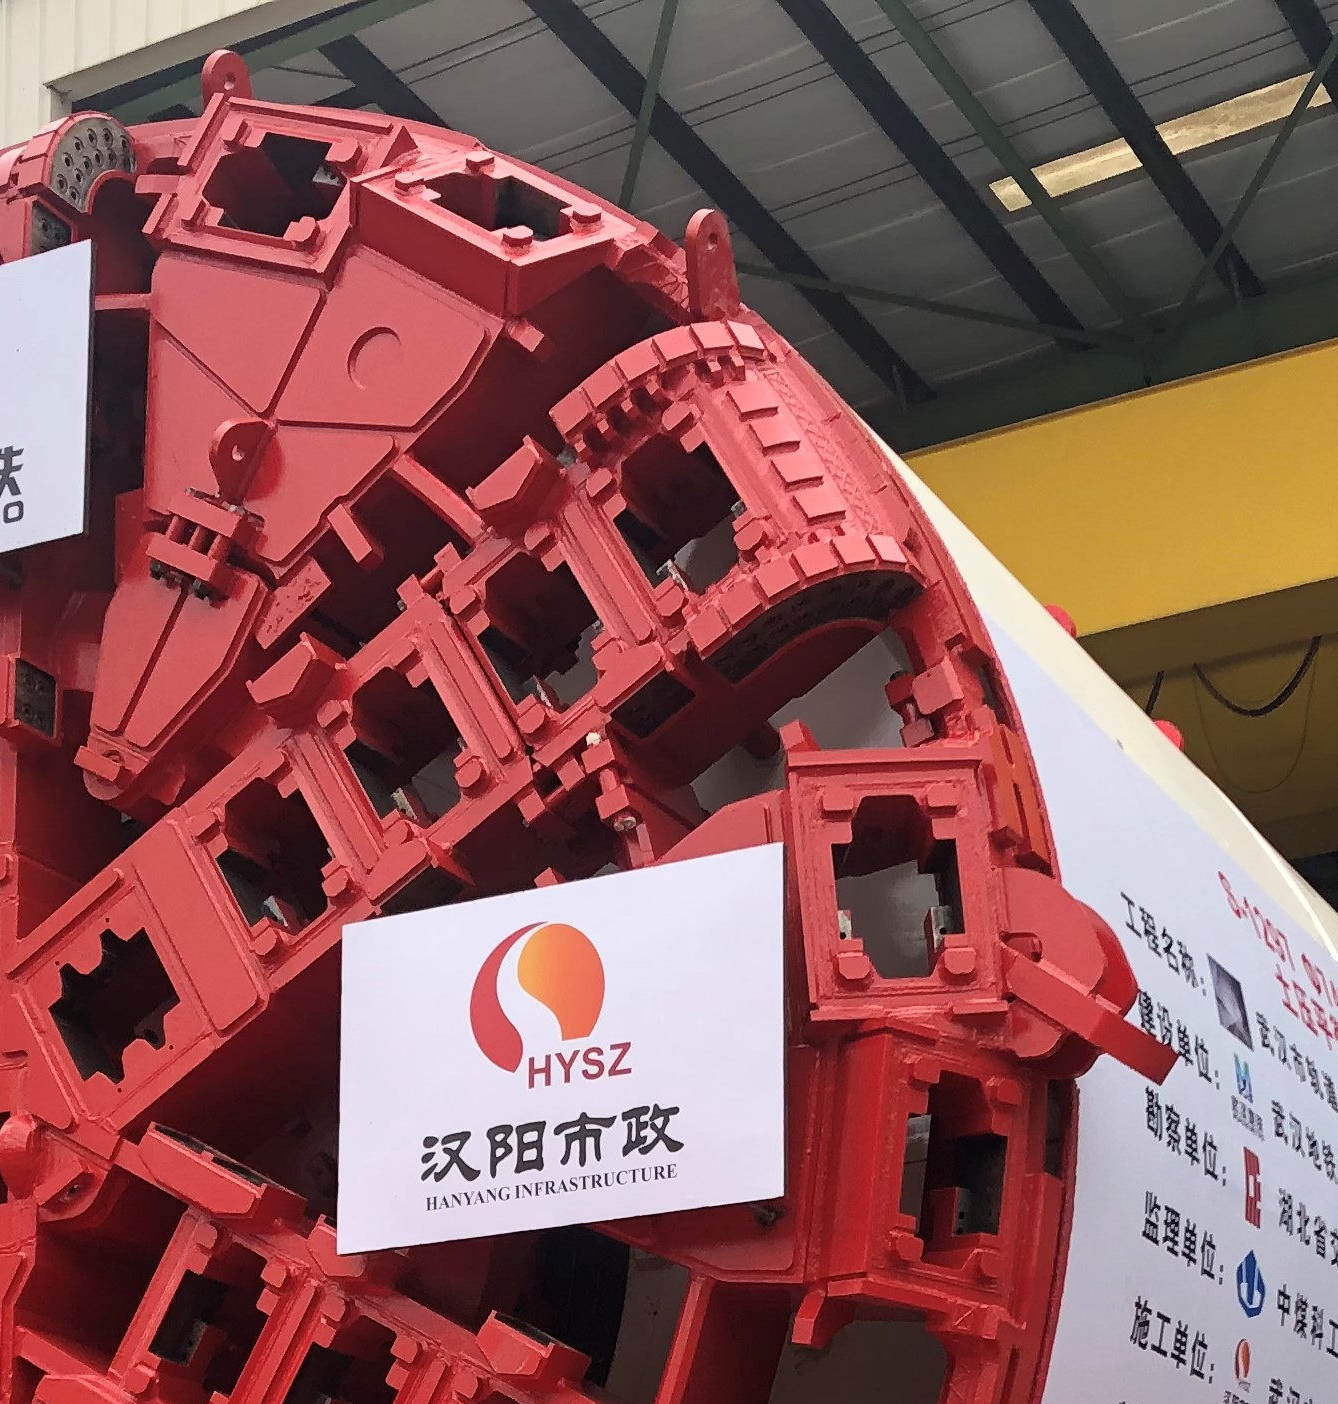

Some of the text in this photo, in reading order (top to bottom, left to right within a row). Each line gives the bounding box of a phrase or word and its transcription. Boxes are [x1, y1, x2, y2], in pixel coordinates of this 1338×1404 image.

[528, 1042, 632, 1089] HYSZ
[420, 1103, 684, 1183] 汉阳市政
[425, 1163, 678, 1211] HANYANG INFRASTRUCTURE
